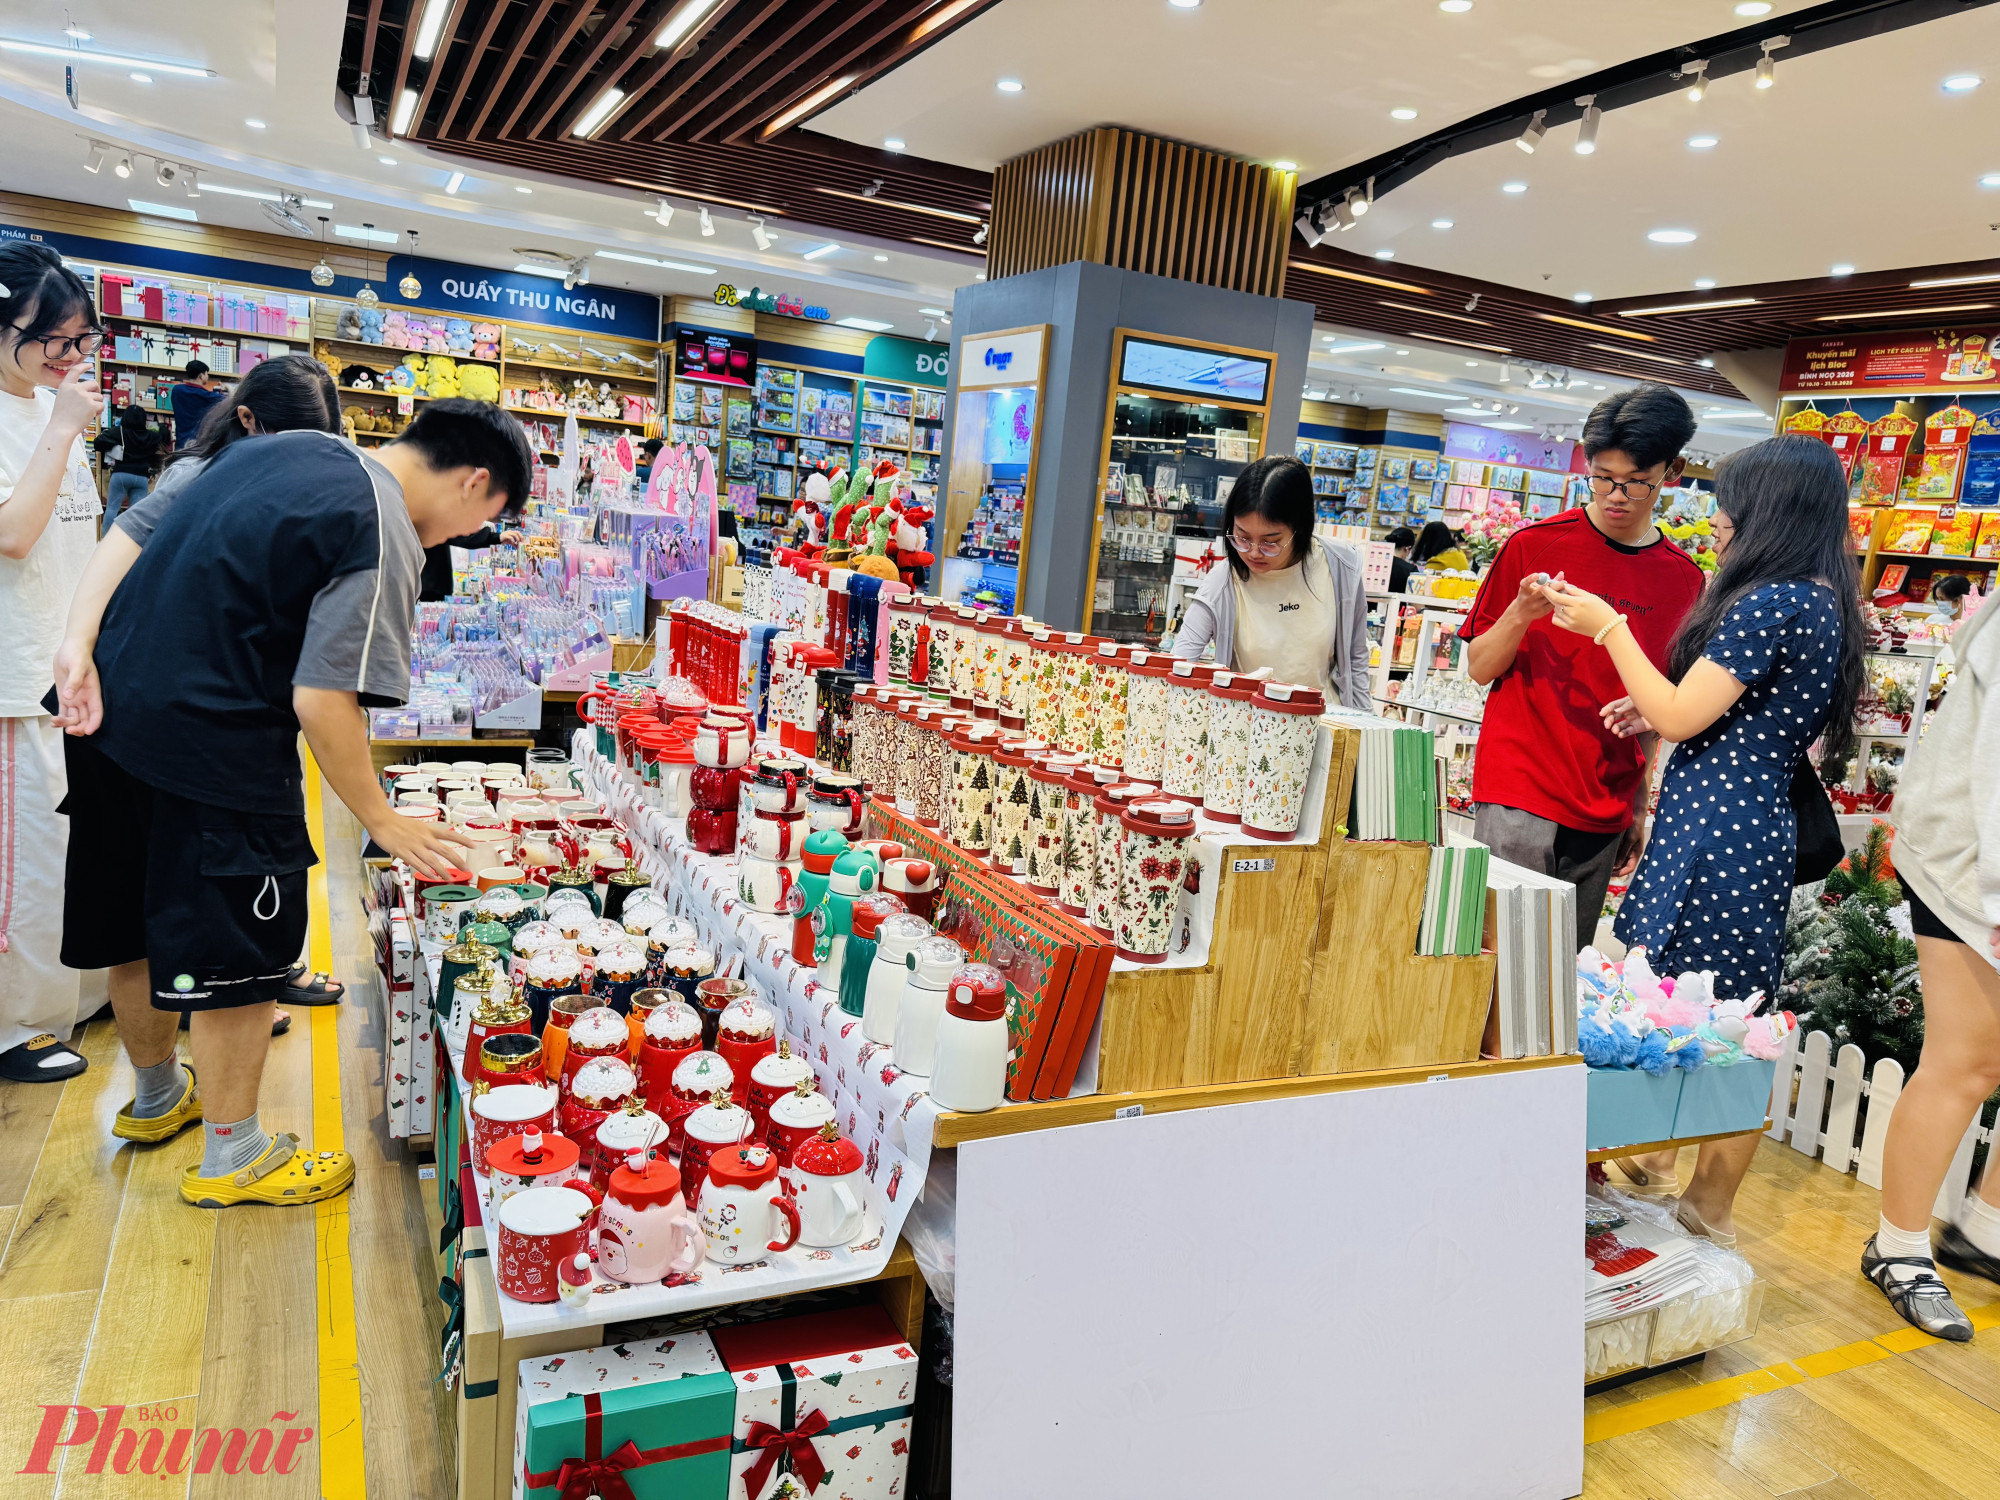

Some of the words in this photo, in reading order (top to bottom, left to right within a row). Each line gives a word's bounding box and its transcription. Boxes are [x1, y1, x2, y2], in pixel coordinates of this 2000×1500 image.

[441, 279, 502, 302] QUẦY
[506, 288, 550, 310] THU
[555, 296, 616, 320] NGÂN
[714, 283, 741, 306] Đồ
[741, 287, 776, 312] chơi
[776, 294, 803, 316] trẻ
[803, 305, 830, 320] em
[1806, 349, 1838, 360] Khuyến
[1839, 348, 1857, 358] mãi
[916, 351, 949, 376] ĐỒ
[1810, 361, 1826, 371] lịch
[1827, 361, 1847, 369] Bloc
[1799, 372, 1818, 380] BÍNH
[1819, 371, 1835, 380] NGỌ
[1836, 371, 1855, 379] 2026
[1940, 507, 1954, 516] 20
[1278, 602, 1300, 613] Jeko
[1234, 860, 1259, 871] E-2-1
[702, 1214, 723, 1231] Merry
